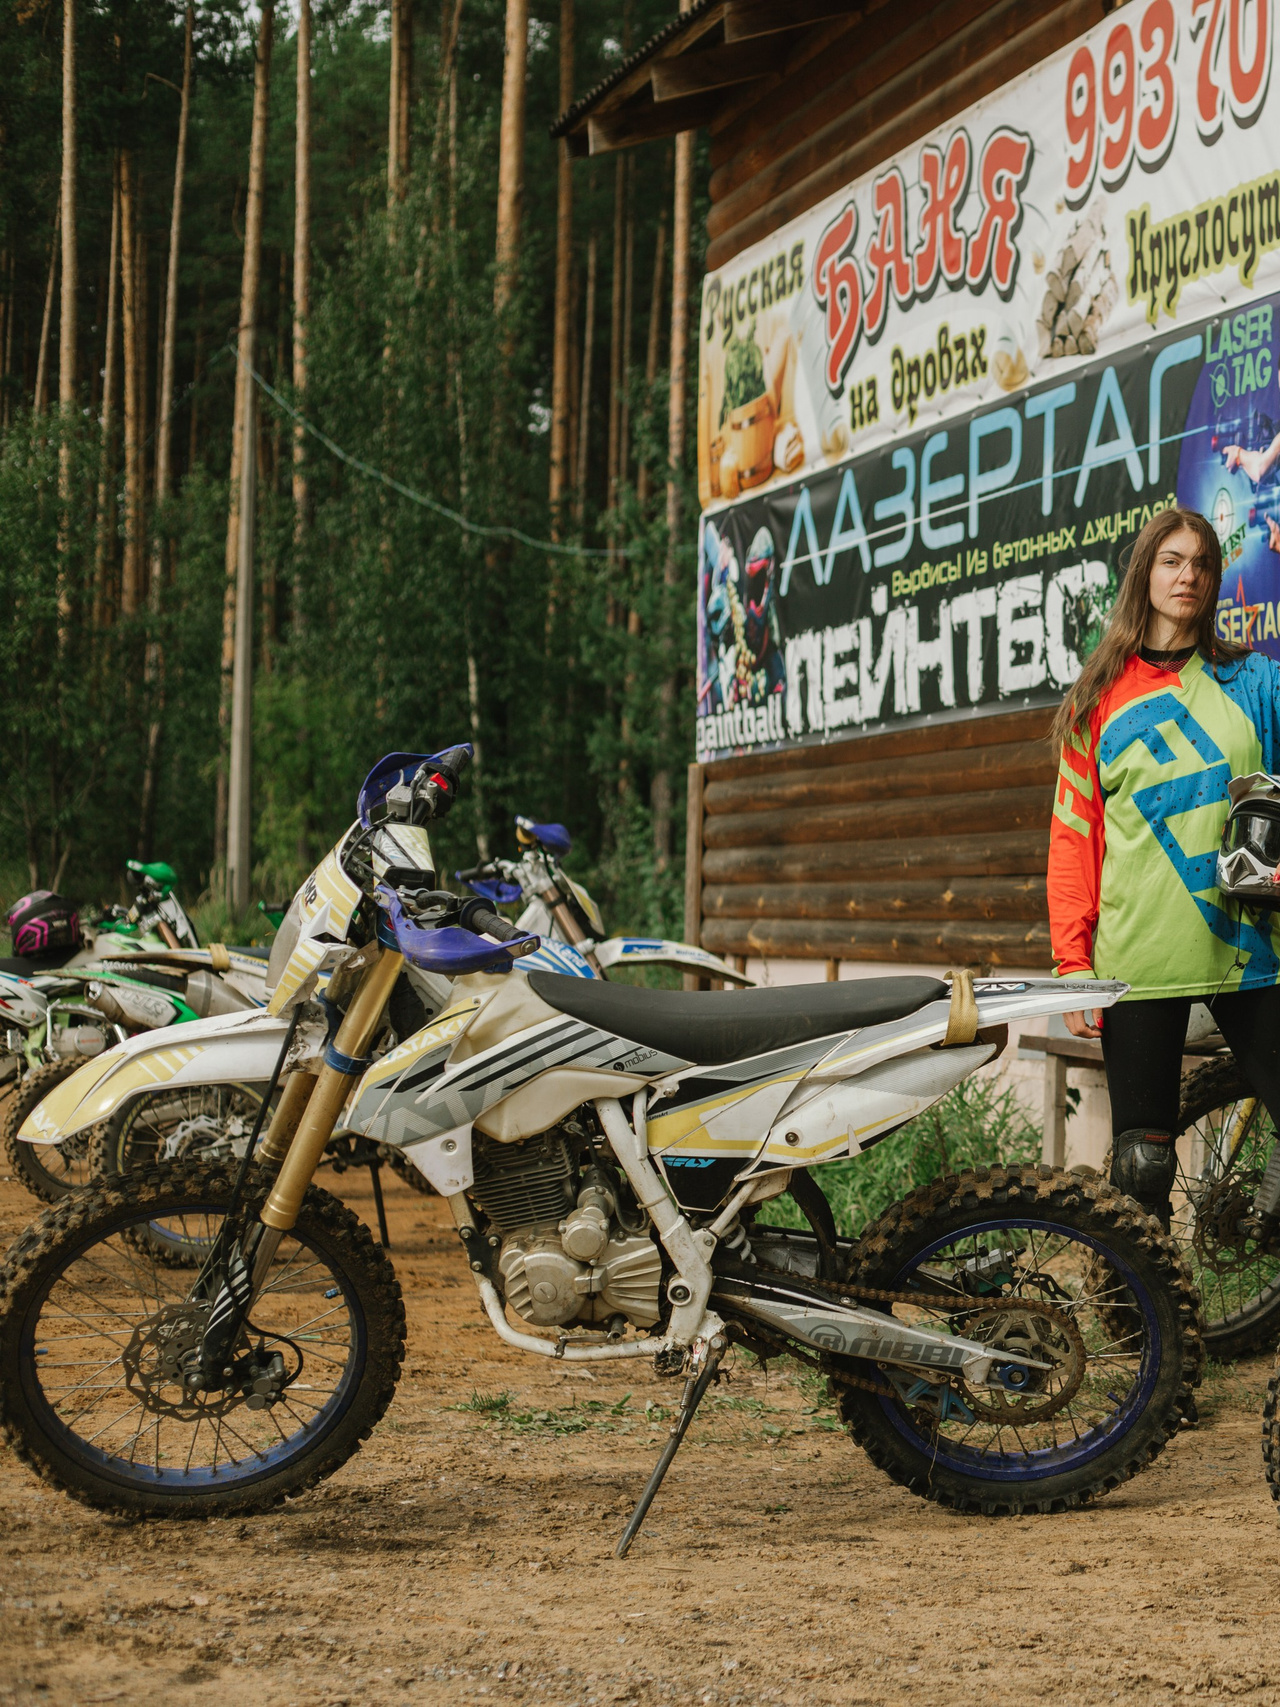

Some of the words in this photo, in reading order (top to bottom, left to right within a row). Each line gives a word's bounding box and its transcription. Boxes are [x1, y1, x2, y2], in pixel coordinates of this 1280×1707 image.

[1064, 0, 1178, 206] 993
[813, 127, 1033, 397] БАНЯ
[704, 241, 805, 346] Русская
[1205, 304, 1274, 364] LASER
[850, 377, 879, 431] на
[891, 326, 988, 424] дровах
[1232, 348, 1273, 397] TAG
[779, 335, 1204, 596] ЛАЗЕРТАГ
[966, 548, 989, 576] Из
[993, 525, 1077, 569] бетонных
[785, 560, 1110, 736] ПЕЙНТБО
[697, 693, 785, 752] paintball
[386, 1019, 466, 1062] ATAKI
[625, 1049, 658, 1069] mobius
[661, 1156, 717, 1168] FLY
